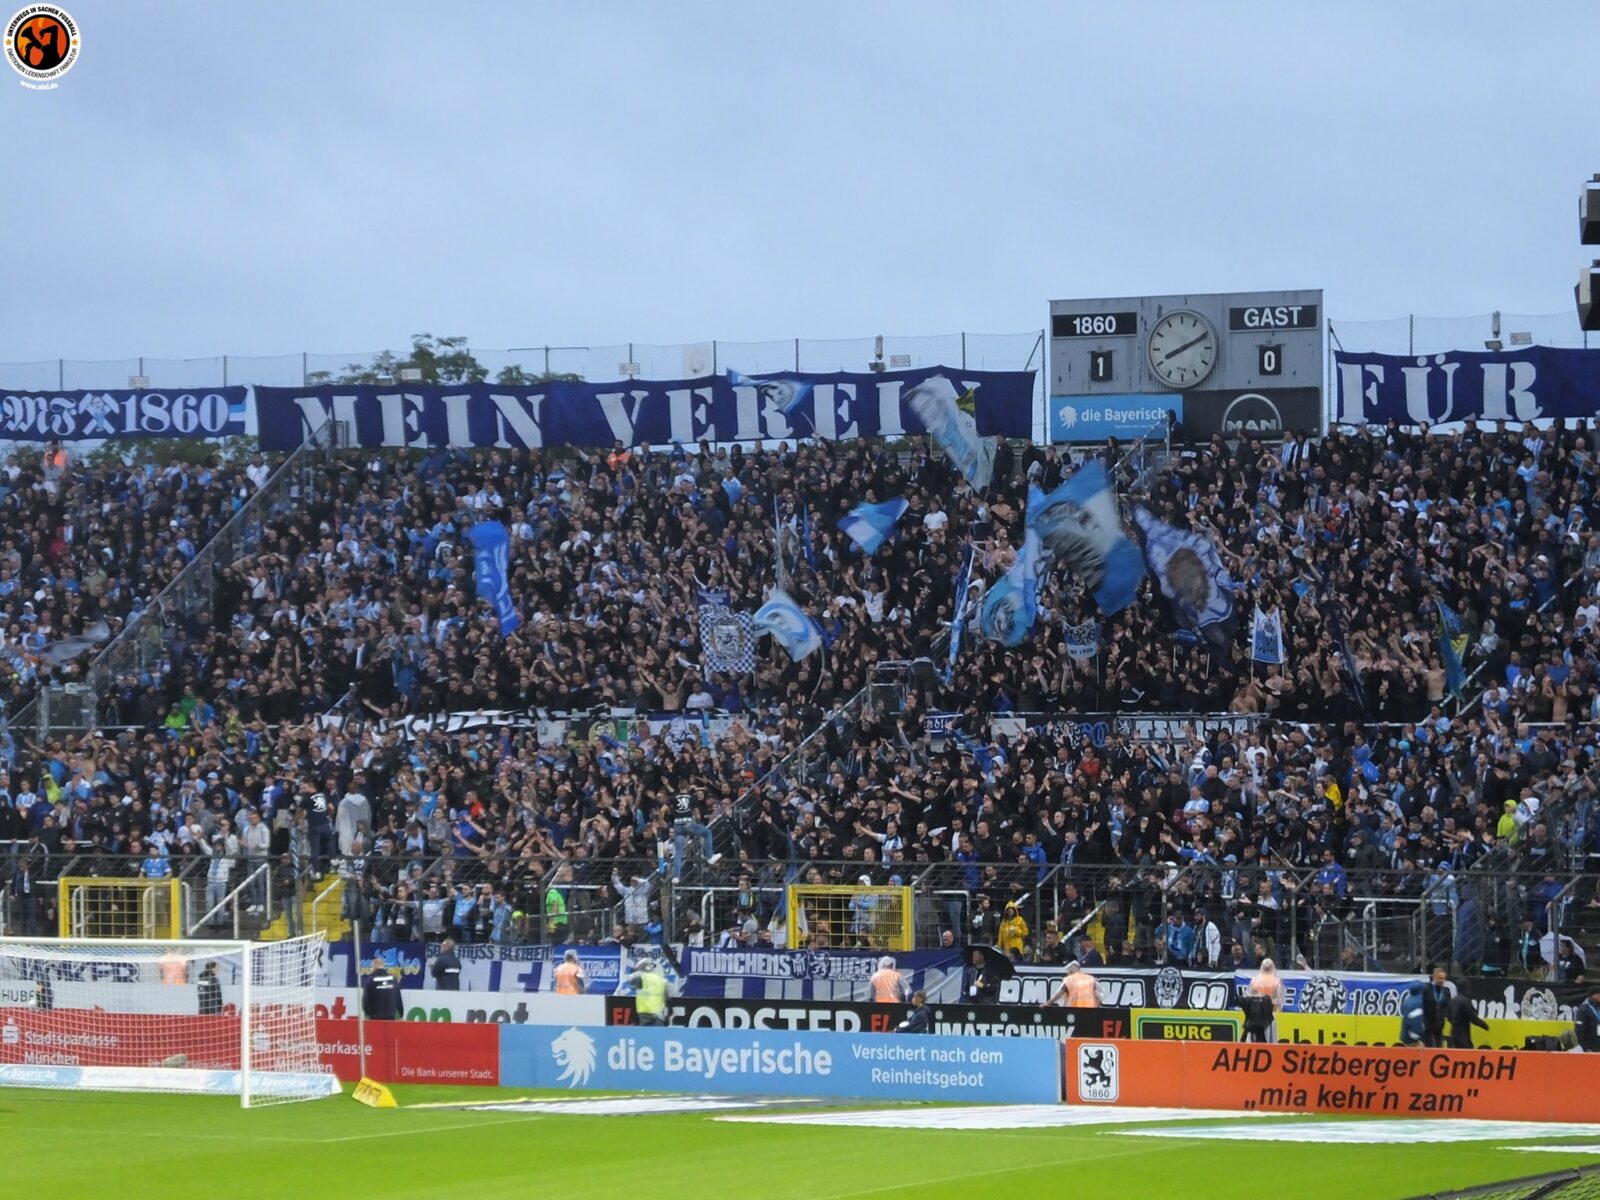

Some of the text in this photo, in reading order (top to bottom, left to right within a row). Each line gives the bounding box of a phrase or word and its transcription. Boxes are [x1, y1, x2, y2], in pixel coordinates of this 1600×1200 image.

[1072, 315, 1117, 334] 1860
[1243, 306, 1302, 327] GAST
[1096, 356, 1105, 377] 1
[1263, 350, 1276, 371] 0
[1337, 353, 1544, 425] FÜR
[121, 393, 229, 433] 1860
[294, 393, 545, 449] MEIN
[595, 380, 981, 447] VEREI
[1080, 405, 1168, 423] die Bayerisch
[1225, 418, 1277, 431] MAN
[458, 944, 494, 960] MUSS
[691, 949, 793, 976] MÜNCHENS
[829, 956, 878, 975] JUGEN
[1190, 983, 1227, 1010] 90
[24, 1031, 118, 1048] Stadtsparkasse
[1163, 1025, 1211, 1040] BURG
[24, 1051, 79, 1065] München
[607, 1038, 832, 1079] die Bayerische
[852, 1044, 1004, 1065] Versichert nach dem
[401, 1067, 415, 1077] Die
[416, 1067, 436, 1078] Bank
[437, 1070, 468, 1079] unserer
[1211, 1047, 1517, 1084] AHD Sitzberger GmbH
[871, 1067, 984, 1089] Reinheitsgebot
[1087, 1089, 1111, 1098] 1860
